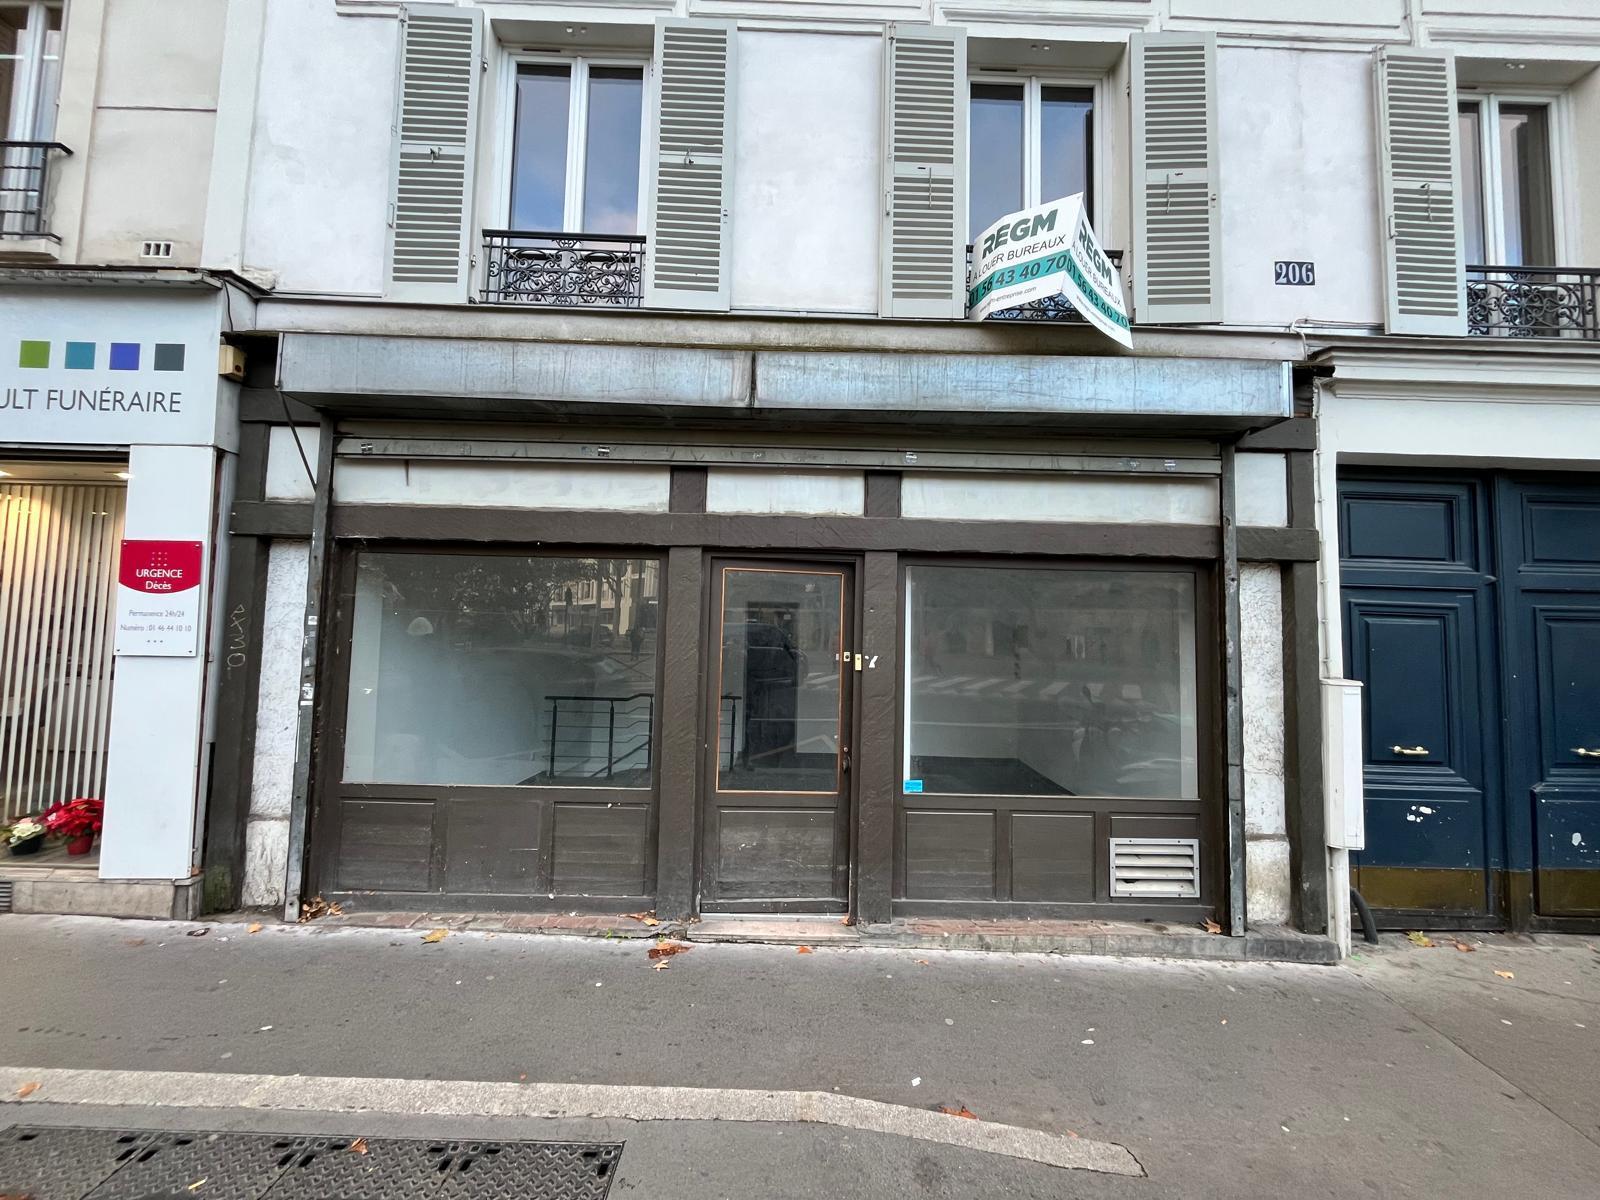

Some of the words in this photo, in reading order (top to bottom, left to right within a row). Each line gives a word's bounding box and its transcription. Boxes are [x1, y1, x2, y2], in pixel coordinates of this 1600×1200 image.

[982, 209, 1058, 260] REGM
[1007, 234, 1066, 261] BUREAUX
[1079, 219, 1113, 287] REGM
[981, 276, 993, 297] 56
[995, 269, 1015, 286] 43
[1020, 262, 1041, 279] 40
[1045, 254, 1068, 273] 70
[1275, 262, 1314, 284] 206
[1066, 258, 1076, 279] 01
[1077, 274, 1088, 294] 56
[1088, 288, 1100, 308] 43
[1101, 301, 1113, 318] 40
[1115, 309, 1128, 328] 70
[46, 386, 182, 413] FUNÉRAIRE
[136, 568, 183, 579] URGENCE
[145, 580, 172, 590] Décès
